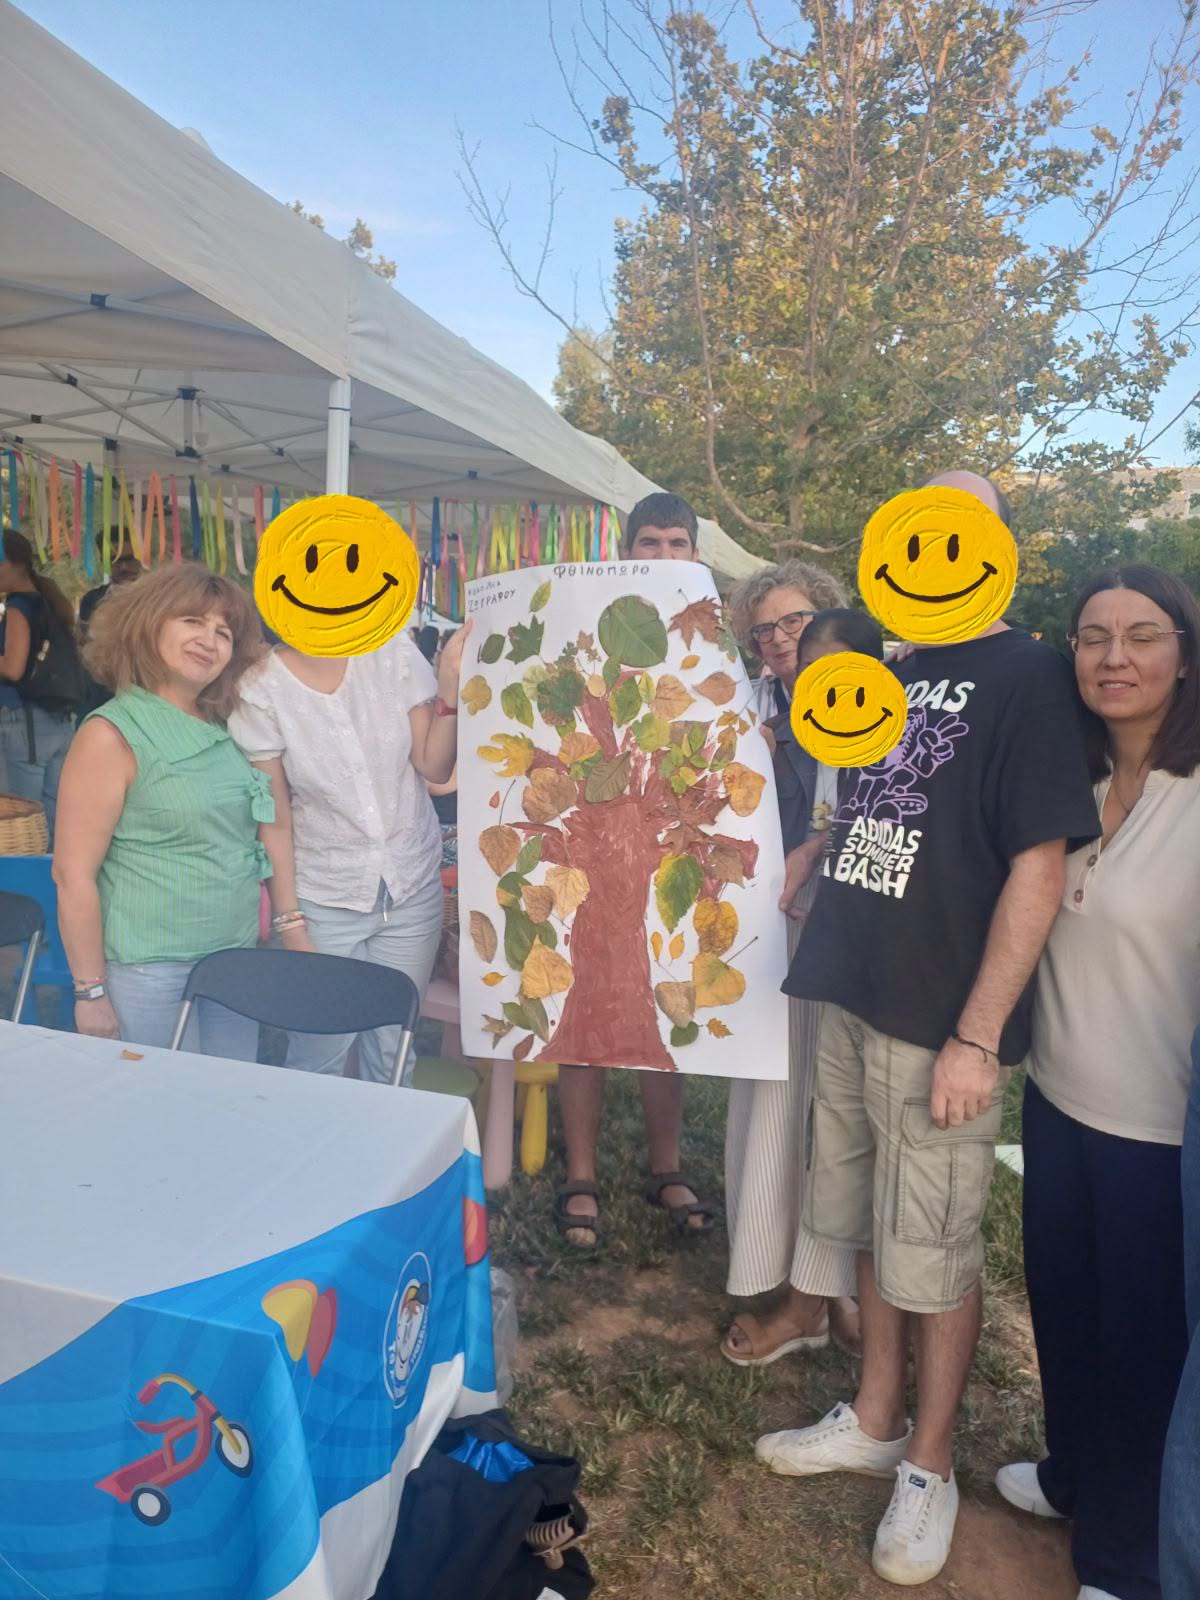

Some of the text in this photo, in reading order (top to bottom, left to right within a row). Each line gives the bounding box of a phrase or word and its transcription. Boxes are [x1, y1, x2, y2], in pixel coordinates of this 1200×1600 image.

[904, 679, 976, 713] DAS
[849, 815, 923, 855] ADIDAS
[841, 836, 915, 873] SUMMER
[833, 853, 909, 899] BASH
